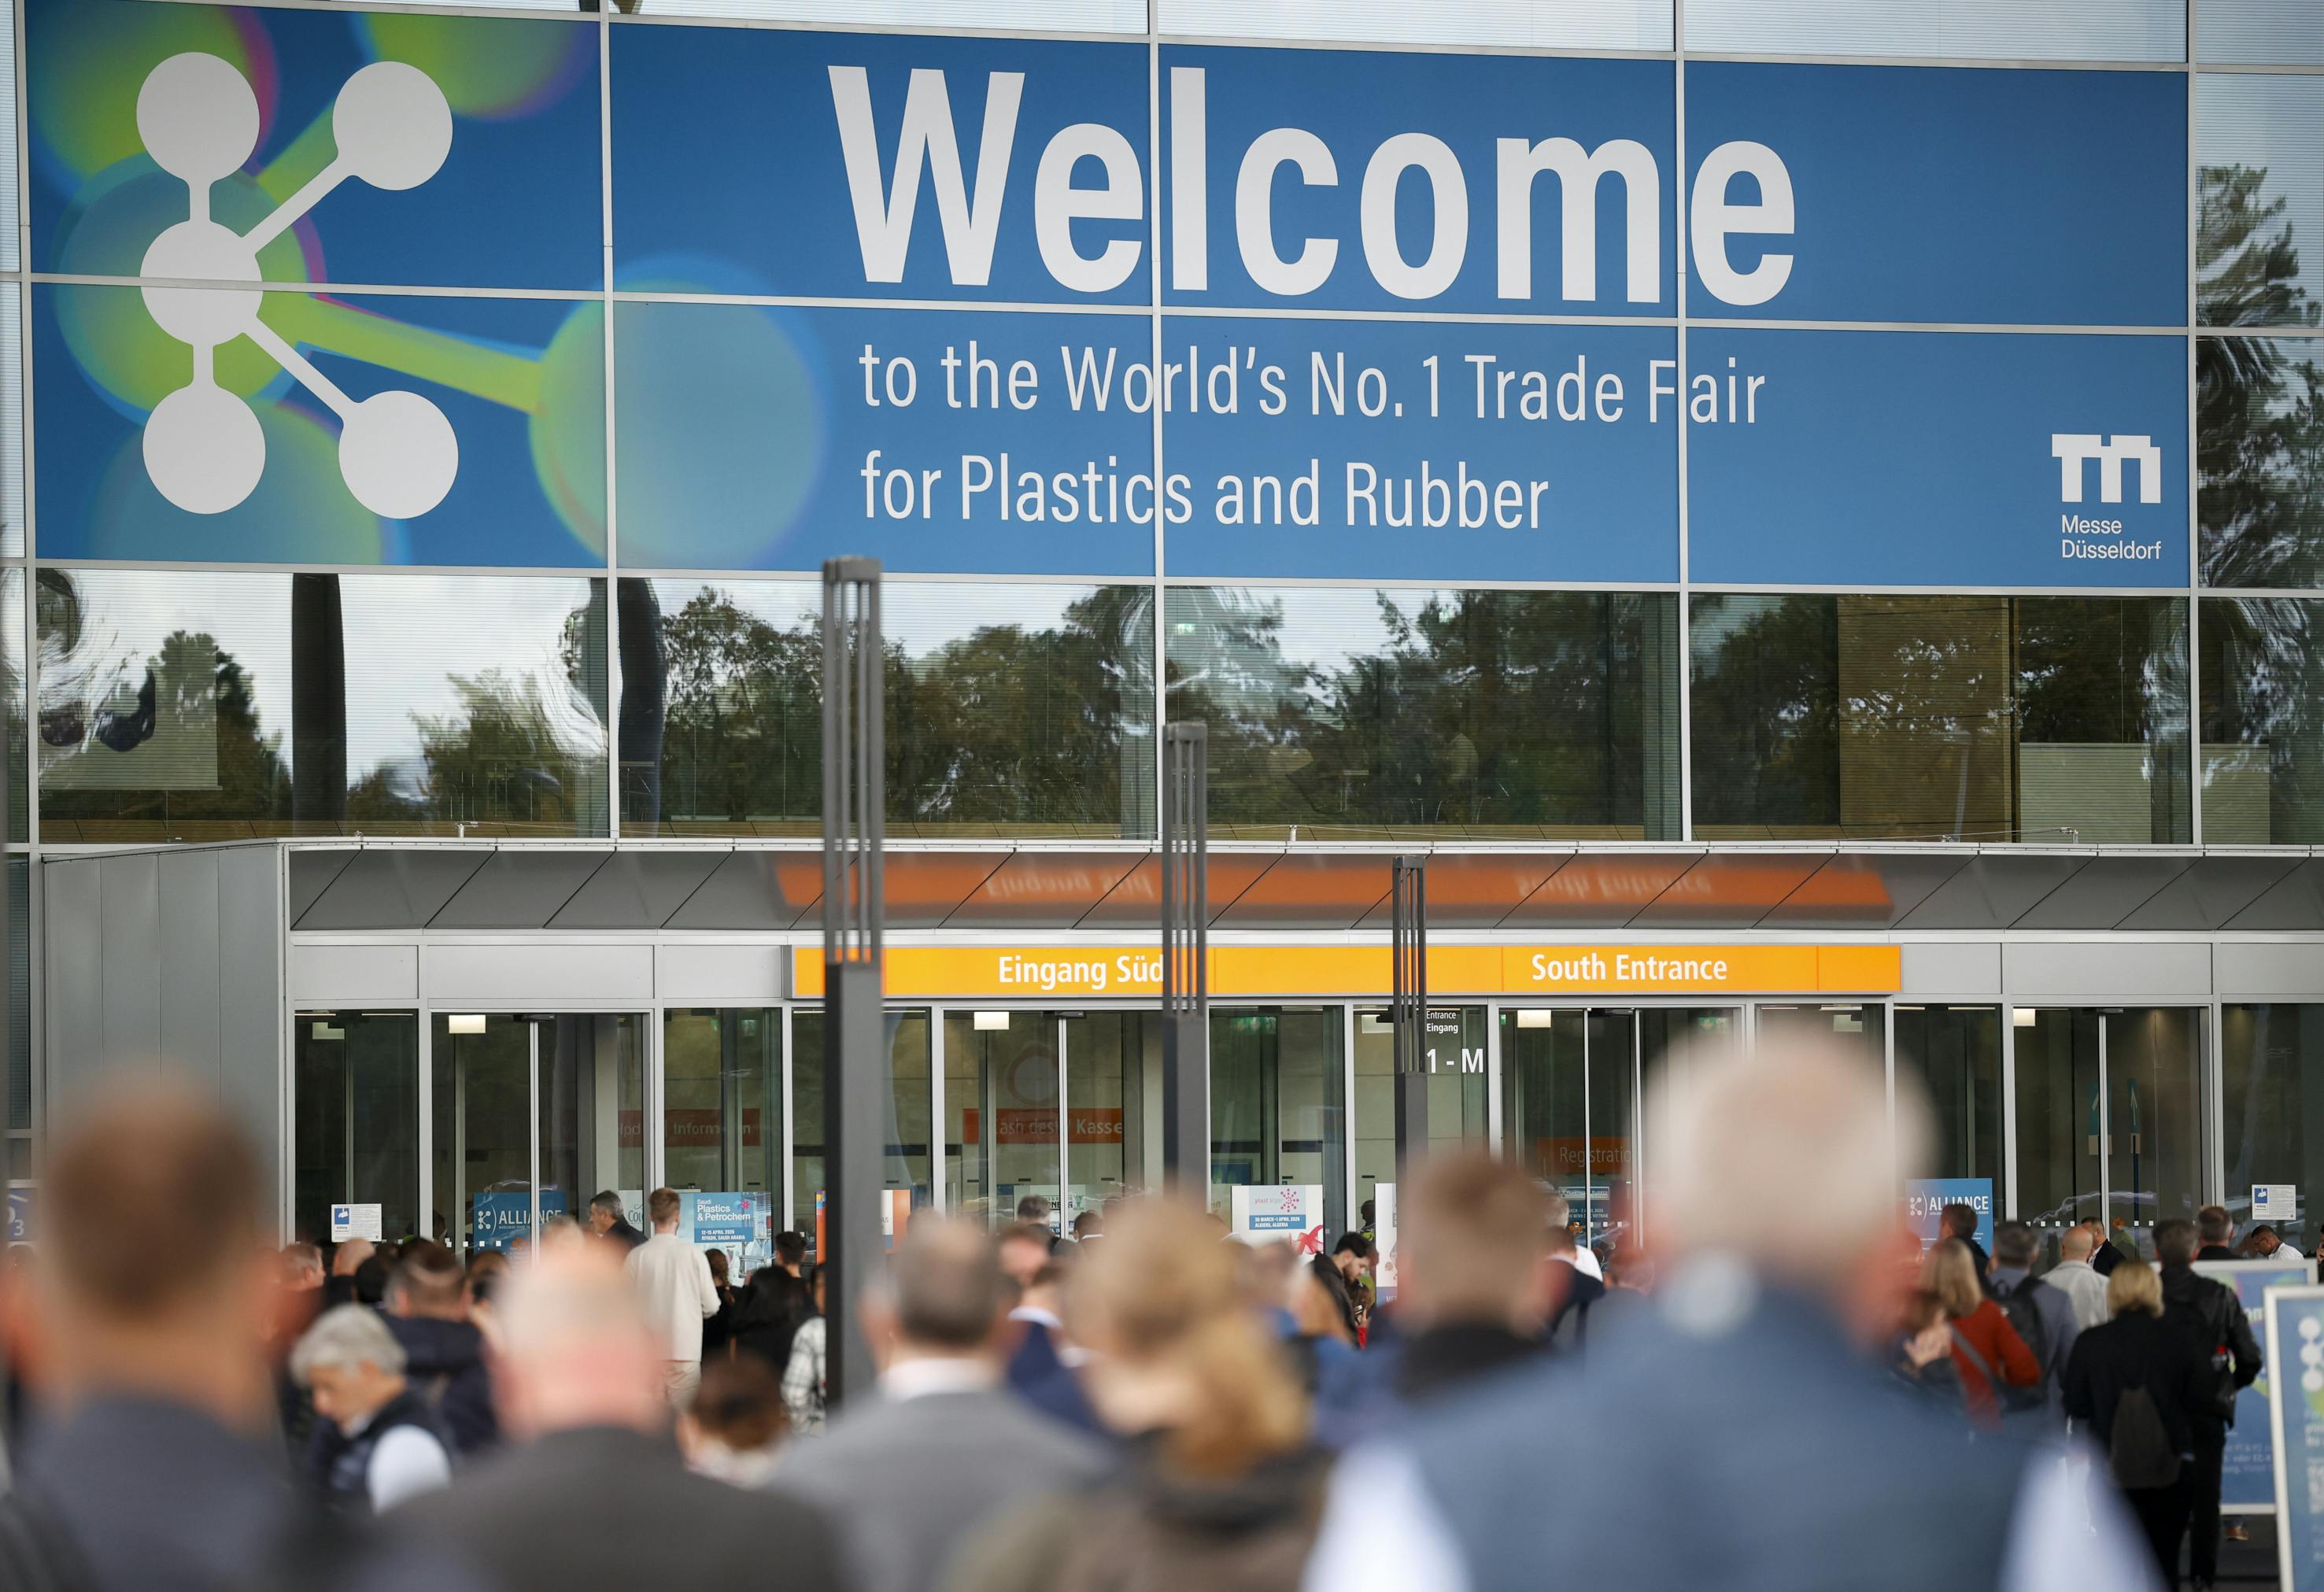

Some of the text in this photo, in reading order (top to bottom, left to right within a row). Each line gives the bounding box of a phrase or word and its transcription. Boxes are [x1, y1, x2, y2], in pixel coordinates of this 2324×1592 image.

[828, 66, 1794, 305] Welcome
[859, 340, 1765, 423] to the World's No. 1 Trade Fair
[860, 449, 1549, 529] for Plastics and Rubber
[2061, 515, 2123, 534] Messe
[2061, 538, 2162, 560] Düsseldorf
[999, 954, 1164, 991] Eingang Süd
[1531, 952, 1728, 981] South Entrance
[1426, 1010, 1457, 1019] Entrance
[1426, 1023, 1459, 1034] Eingang
[1461, 1048, 1483, 1073] M
[697, 1204, 731, 1213] Plastics
[704, 1212, 751, 1221] Petrochem
